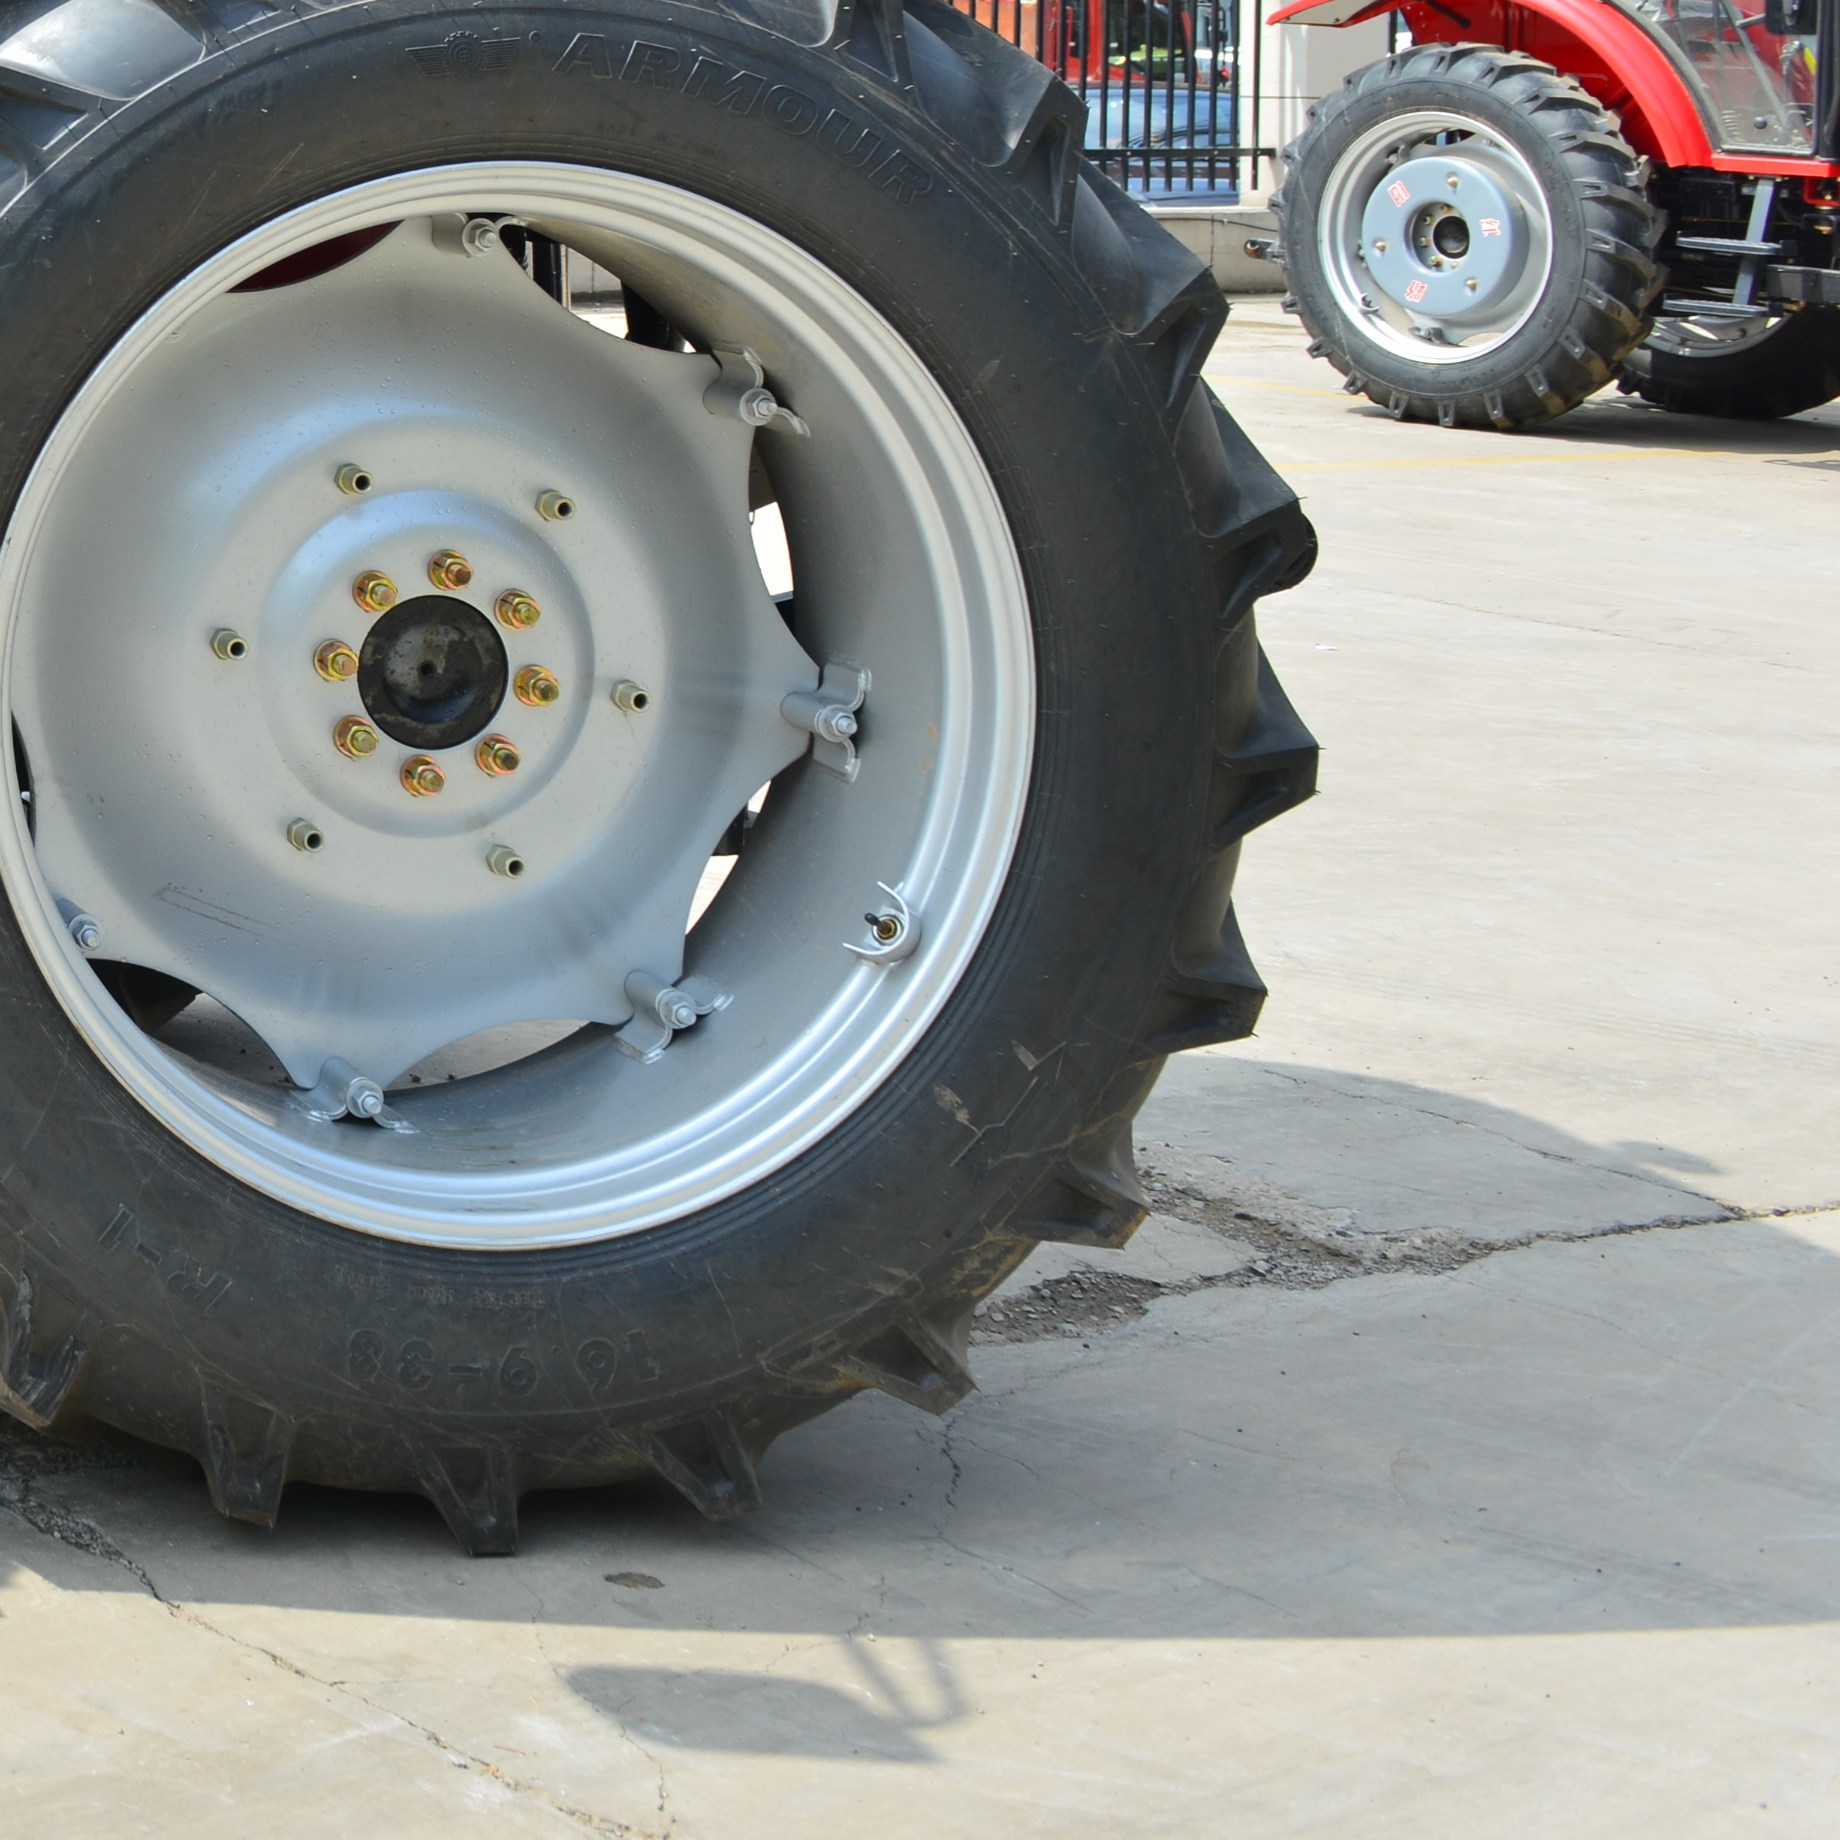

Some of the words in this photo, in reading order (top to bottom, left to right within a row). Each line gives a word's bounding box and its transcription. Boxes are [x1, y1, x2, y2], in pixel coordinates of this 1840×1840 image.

[551, 31, 935, 208] ARMOUR
[97, 1202, 234, 1316] R-1
[345, 1328, 660, 1399] 16.9-38
